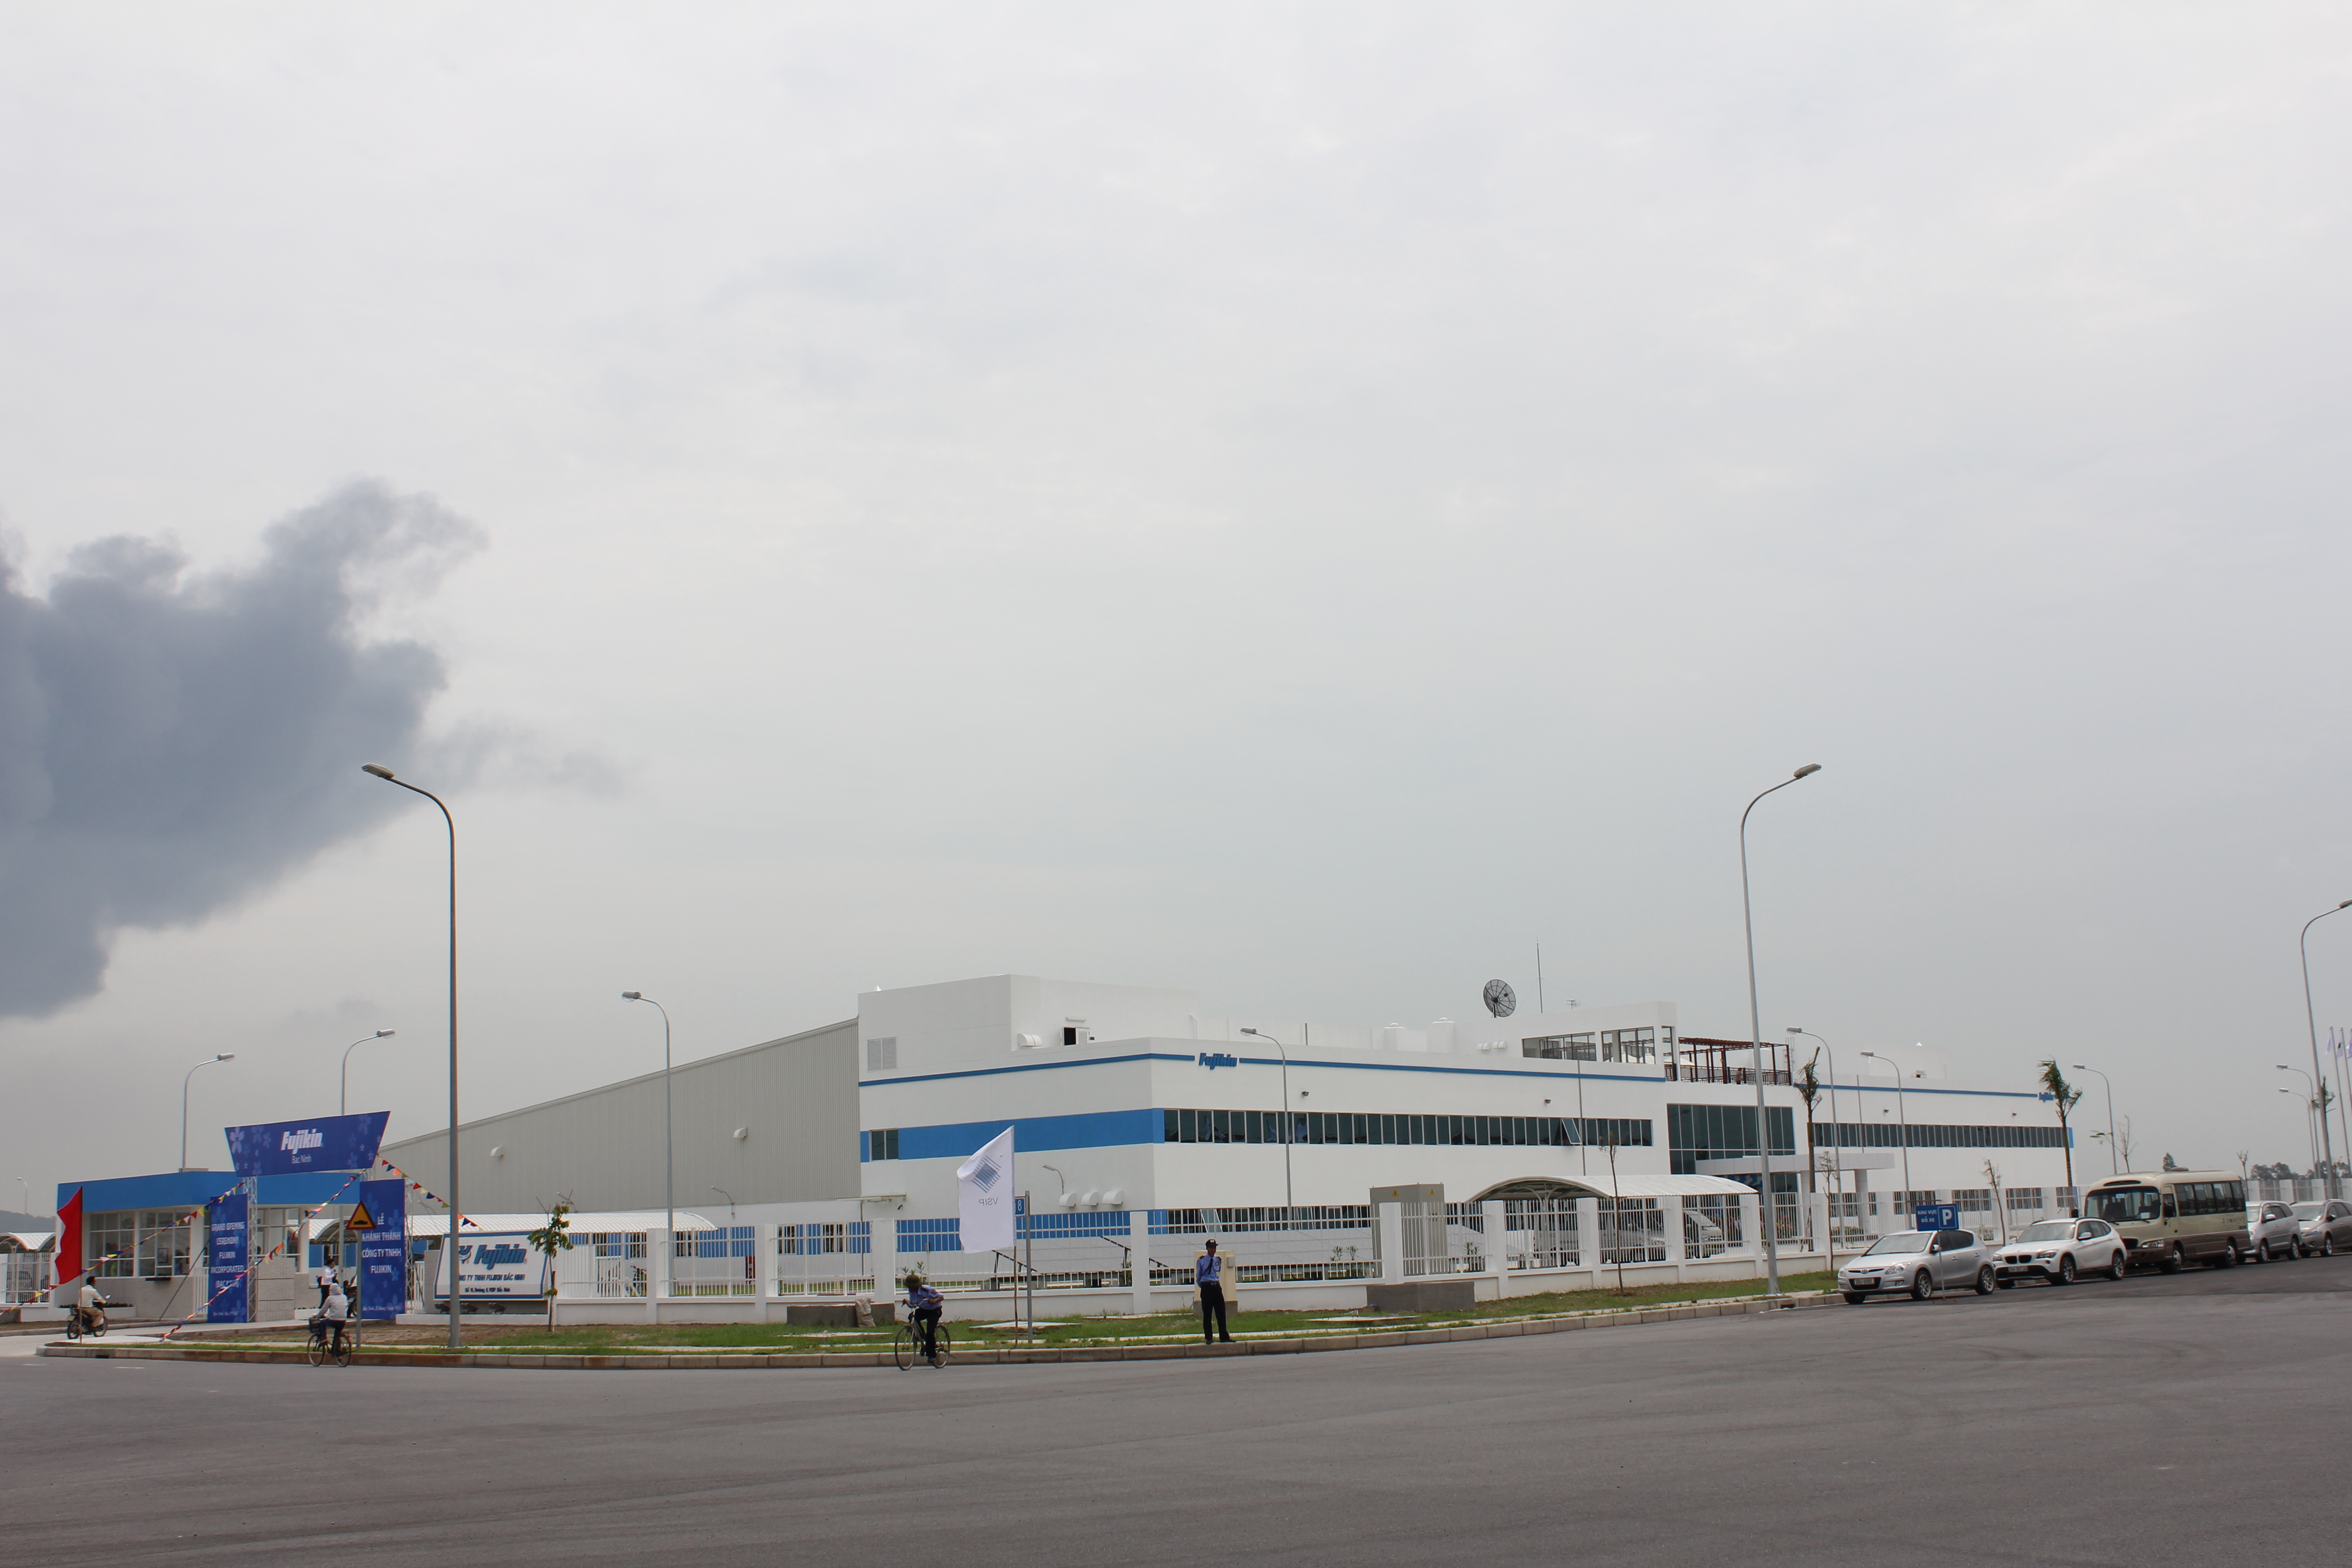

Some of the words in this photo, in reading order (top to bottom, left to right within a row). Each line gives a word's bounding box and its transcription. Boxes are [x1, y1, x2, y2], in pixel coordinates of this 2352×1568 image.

[1199, 1053, 1237, 1070] Fujikin
[281, 1128, 323, 1155] Fujikin
[300, 1154, 312, 1163] Ninh
[1018, 1200, 1022, 1211] 8
[1942, 1209, 1952, 1225] P
[211, 1223, 225, 1231] GRAND
[226, 1221, 245, 1230] OPENING
[216, 1236, 240, 1245] CEREMONY
[362, 1248, 377, 1258] CÔNG
[377, 1249, 385, 1257] TY
[385, 1248, 402, 1257] TNHH
[473, 1244, 527, 1270] Fujikin
[211, 1265, 244, 1274] INCORPORATED
[371, 1265, 392, 1274] FUJIKIN
